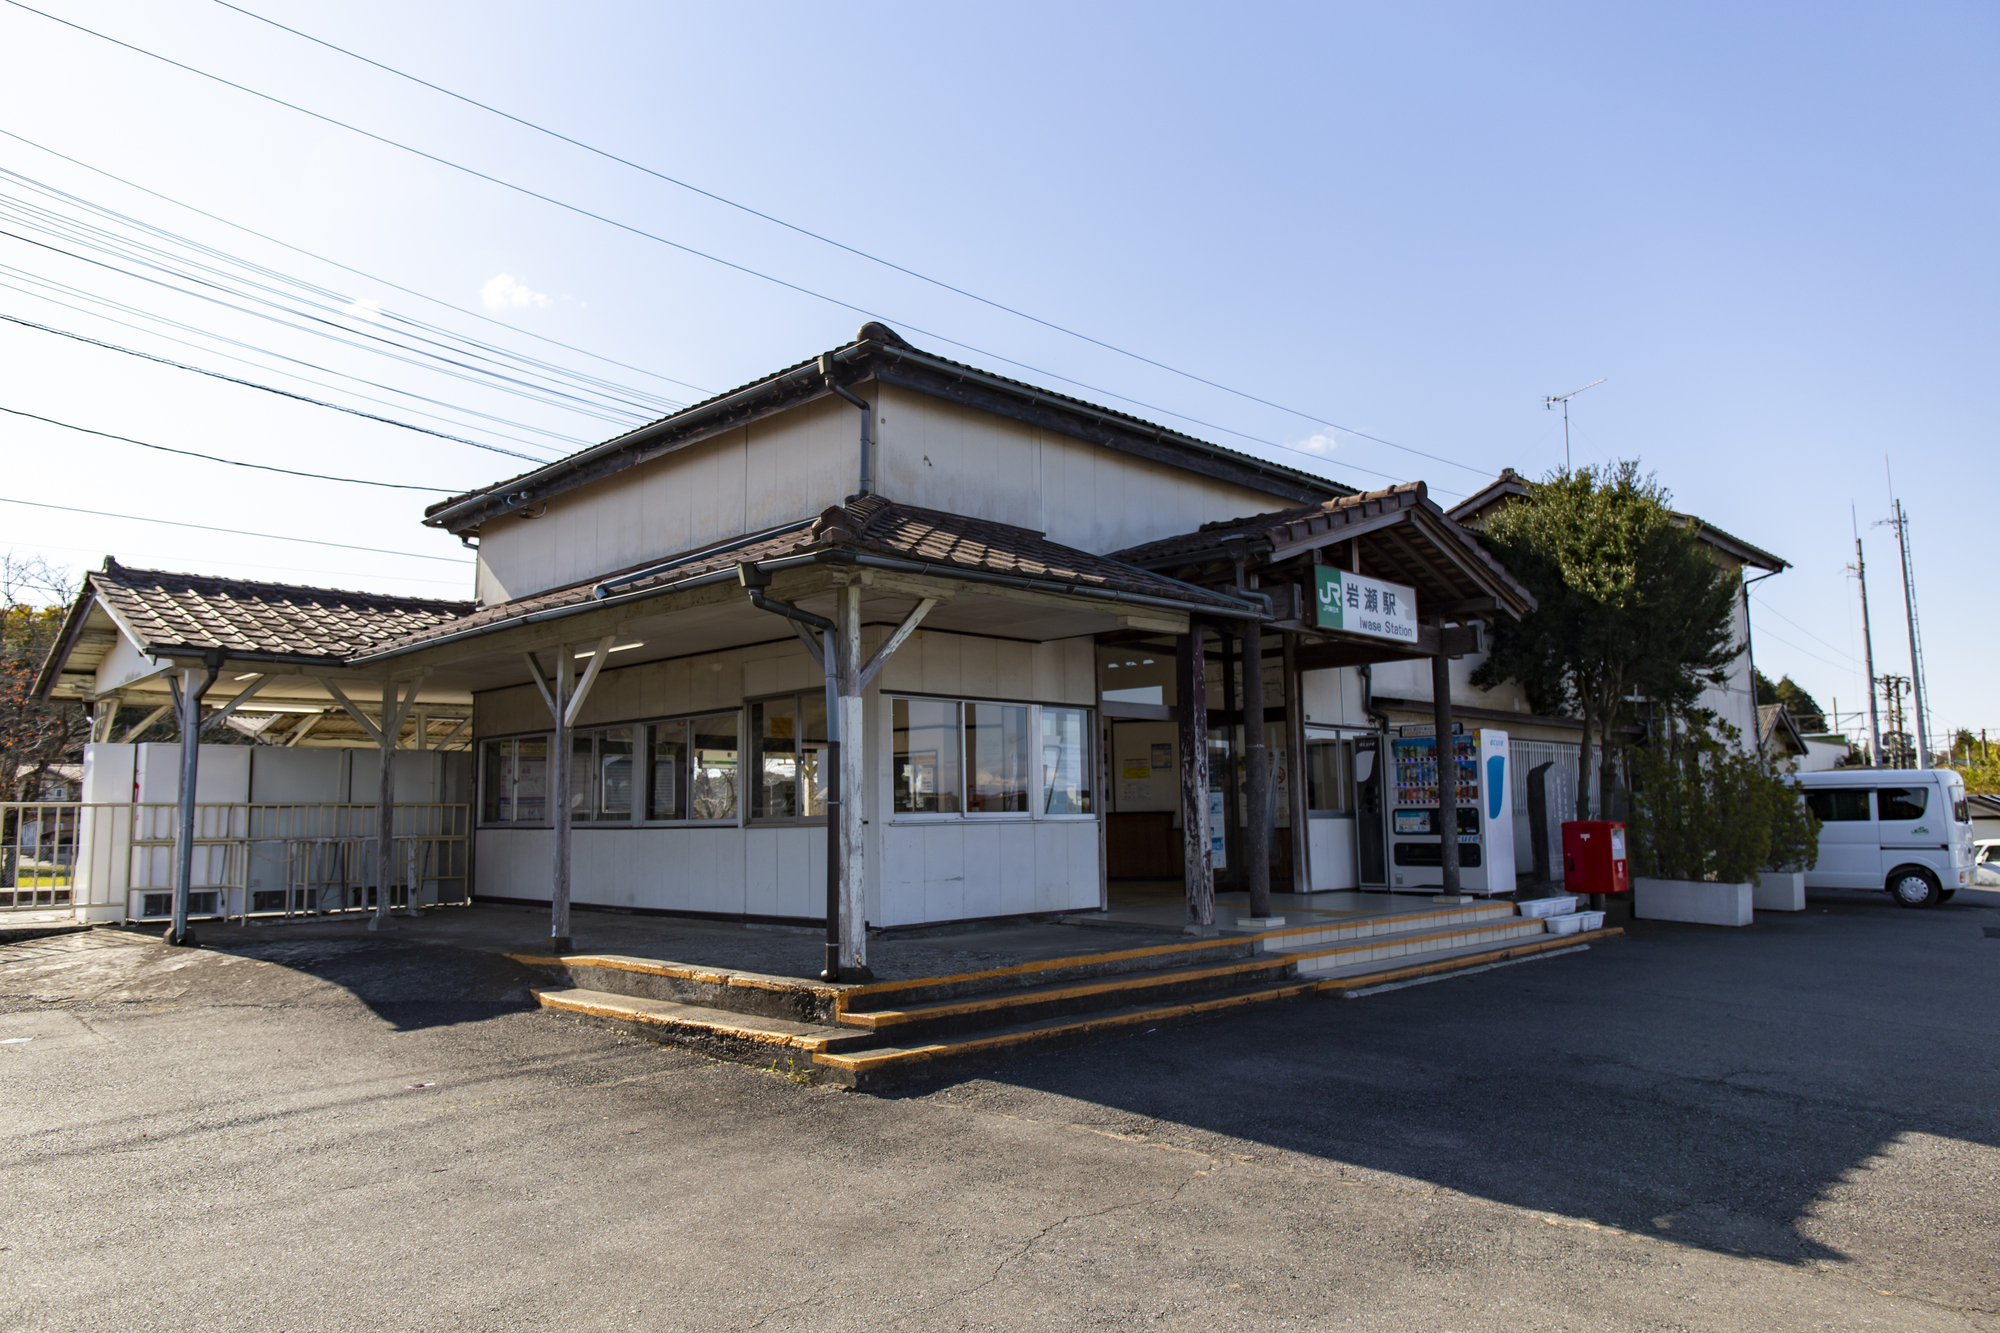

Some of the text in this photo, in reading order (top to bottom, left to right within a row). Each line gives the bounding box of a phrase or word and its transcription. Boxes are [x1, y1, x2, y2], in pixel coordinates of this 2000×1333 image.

[1319, 581, 1342, 607] JR
[1346, 583, 1396, 616] 岩瀬駅
[1359, 616, 1413, 638] Iwase Station
